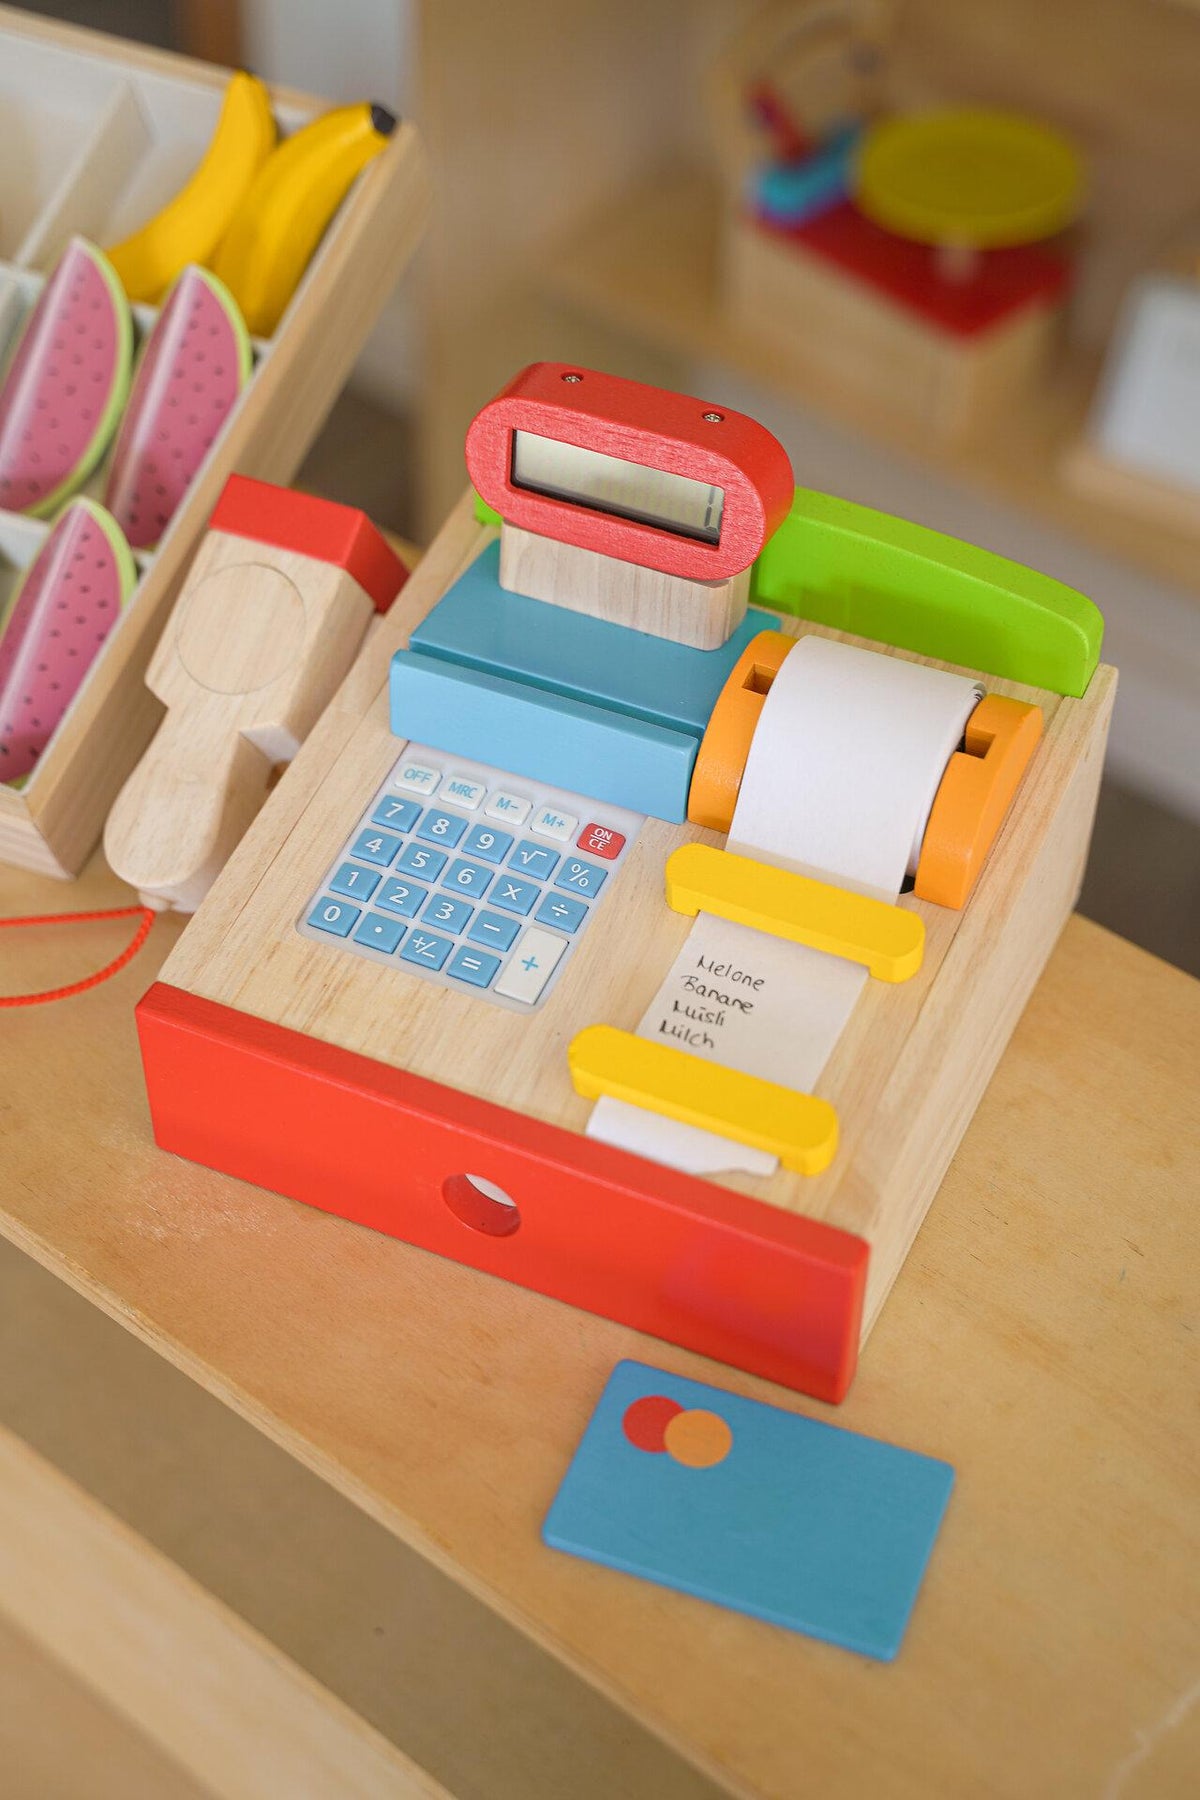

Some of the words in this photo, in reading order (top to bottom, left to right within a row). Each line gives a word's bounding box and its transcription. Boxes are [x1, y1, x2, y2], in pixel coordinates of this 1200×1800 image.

[403, 767, 433, 783] OFF
[448, 781, 478, 799] MRC
[385, 802, 405, 818] 7
[431, 818, 450, 835] 8
[542, 813, 565, 828] M+
[476, 833, 495, 850] 9
[594, 828, 613, 841] ON
[365, 838, 384, 853] 4
[589, 839, 607, 851] CE
[411, 851, 431, 868] 5
[348, 871, 360, 887] 1
[457, 868, 476, 885] 6
[571, 863, 589, 888] %
[389, 886, 409, 905] 2
[323, 905, 341, 922] 0
[435, 902, 455, 920] 3
[461, 956, 482, 971] =
[521, 956, 539, 972] +
[697, 955, 765, 991] Melone
[681, 975, 754, 1014] Banane
[673, 1000, 726, 1026] Müsli
[659, 1019, 714, 1049] Milch
